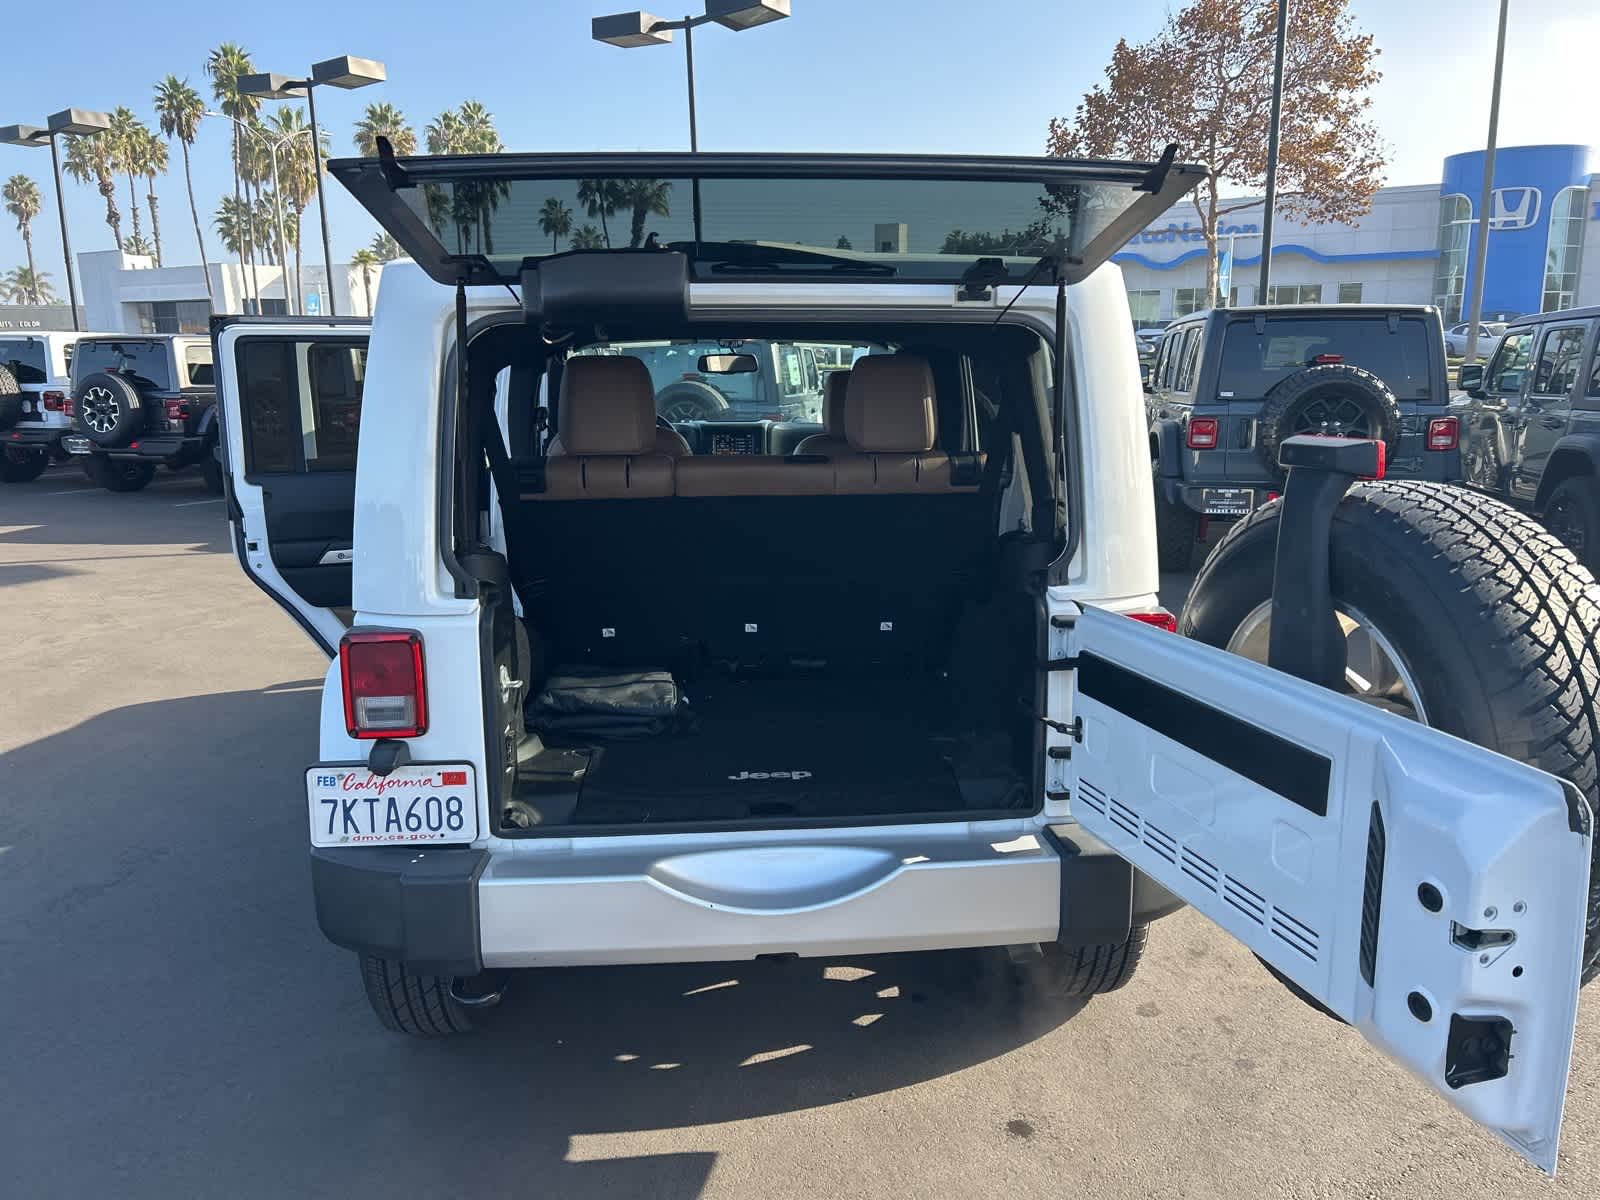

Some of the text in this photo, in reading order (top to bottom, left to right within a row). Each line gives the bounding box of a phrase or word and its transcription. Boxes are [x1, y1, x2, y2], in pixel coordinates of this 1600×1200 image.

[19, 320, 40, 328] COLOR
[727, 771, 812, 780] Jeep
[317, 775, 337, 787] FEB
[342, 772, 443, 795] California
[320, 796, 464, 834] 7KTA608
[352, 833, 437, 842] dmv.ca.gov
